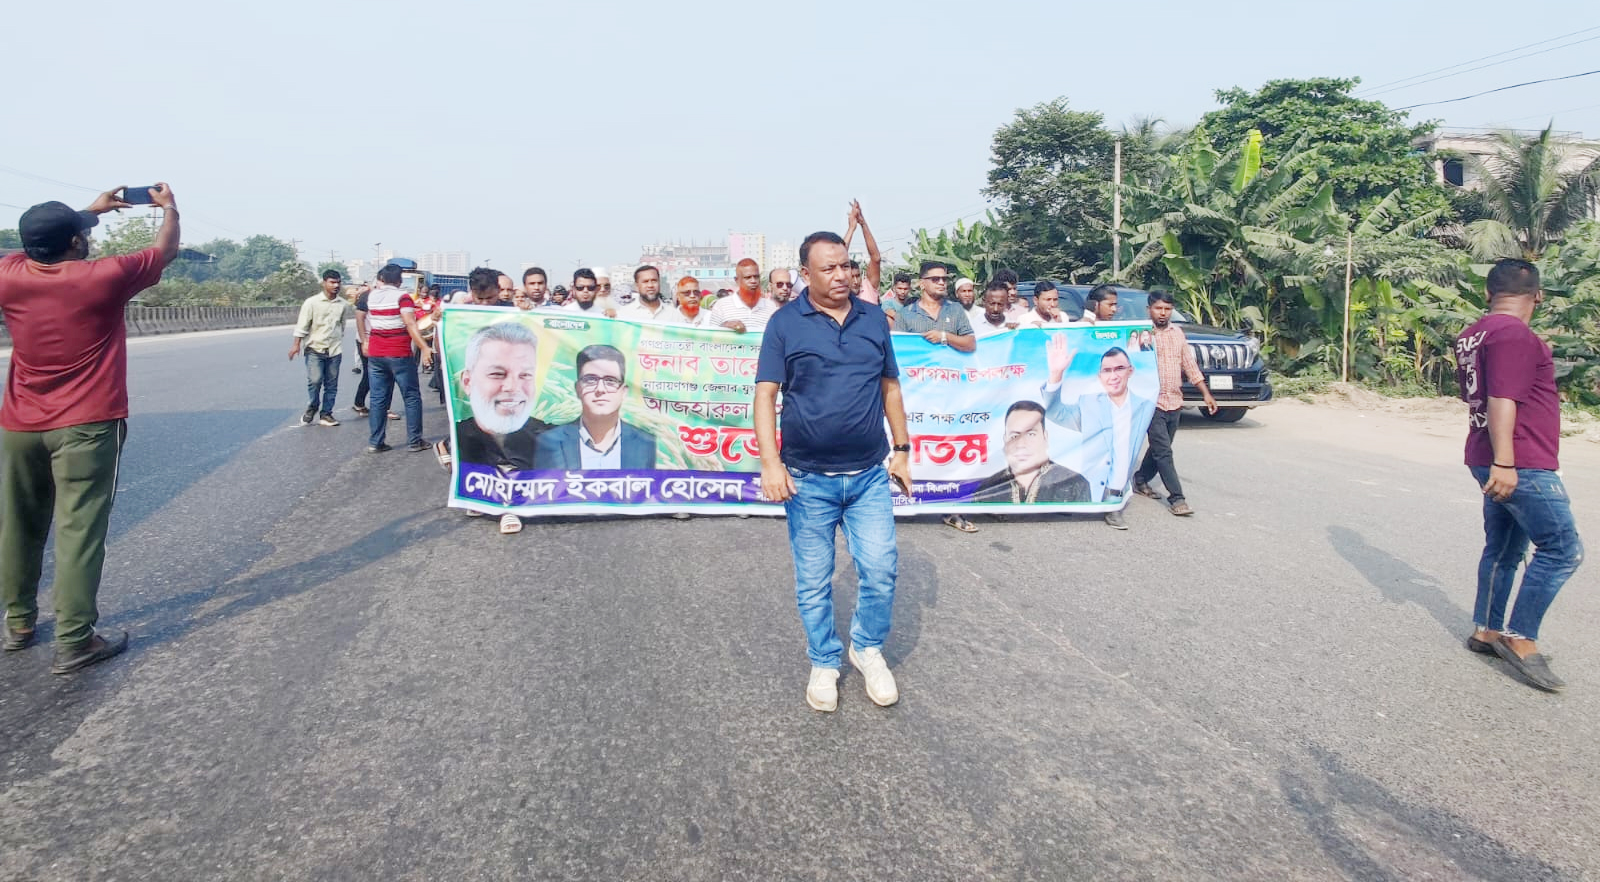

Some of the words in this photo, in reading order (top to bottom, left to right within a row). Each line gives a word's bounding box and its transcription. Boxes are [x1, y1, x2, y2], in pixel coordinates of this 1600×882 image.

[699, 342, 746, 354] বাংলাদেশ
[638, 353, 701, 375] জনাব
[709, 356, 759, 377] তারে
[905, 366, 960, 382] আগমন
[702, 383, 738, 393] জেলার
[643, 396, 751, 419] আজহারুল
[959, 410, 991, 424] থেকে
[465, 471, 559, 500] মোহাম্মদ
[563, 471, 654, 500] ইকবাল
[660, 475, 746, 500] হোসেন
